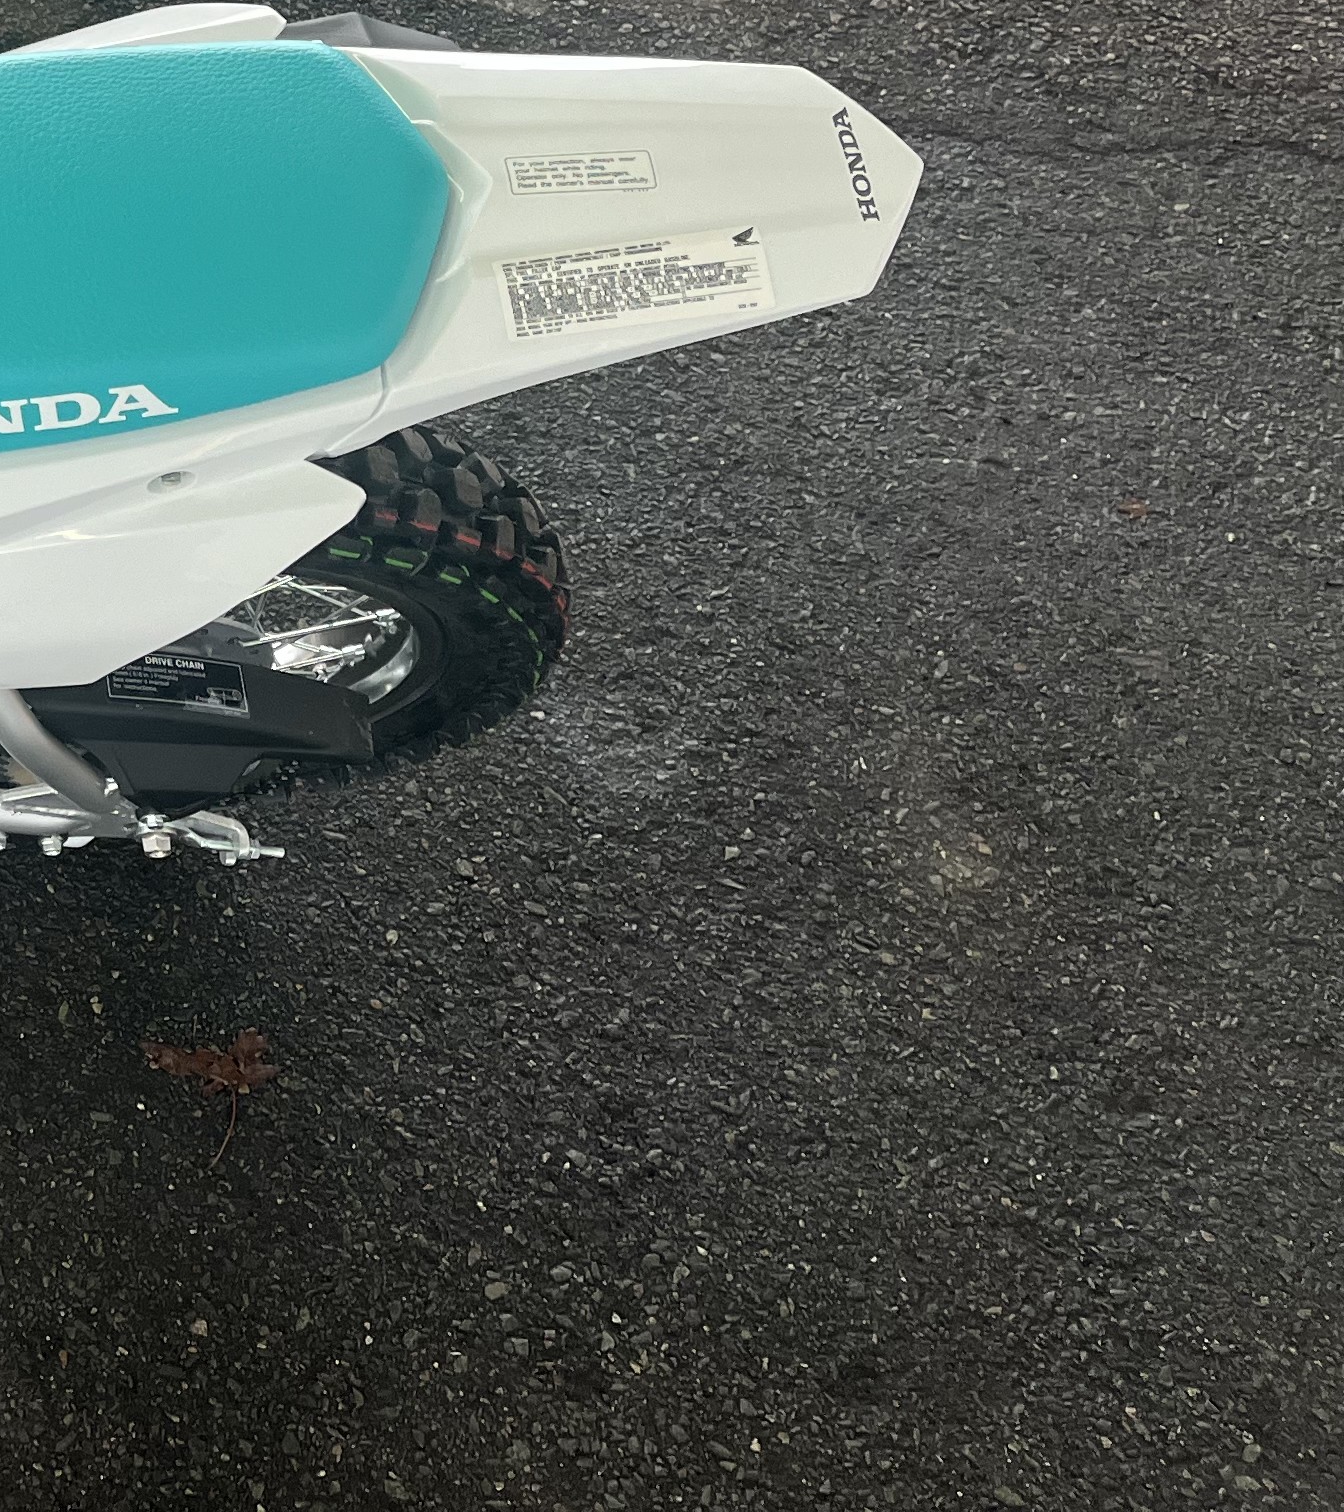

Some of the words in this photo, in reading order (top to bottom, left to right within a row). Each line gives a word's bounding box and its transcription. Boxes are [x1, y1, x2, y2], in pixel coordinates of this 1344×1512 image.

[831, 106, 881, 222] HONDA
[144, 656, 174, 667] DRIVE
[175, 659, 205, 670] CHAIN
